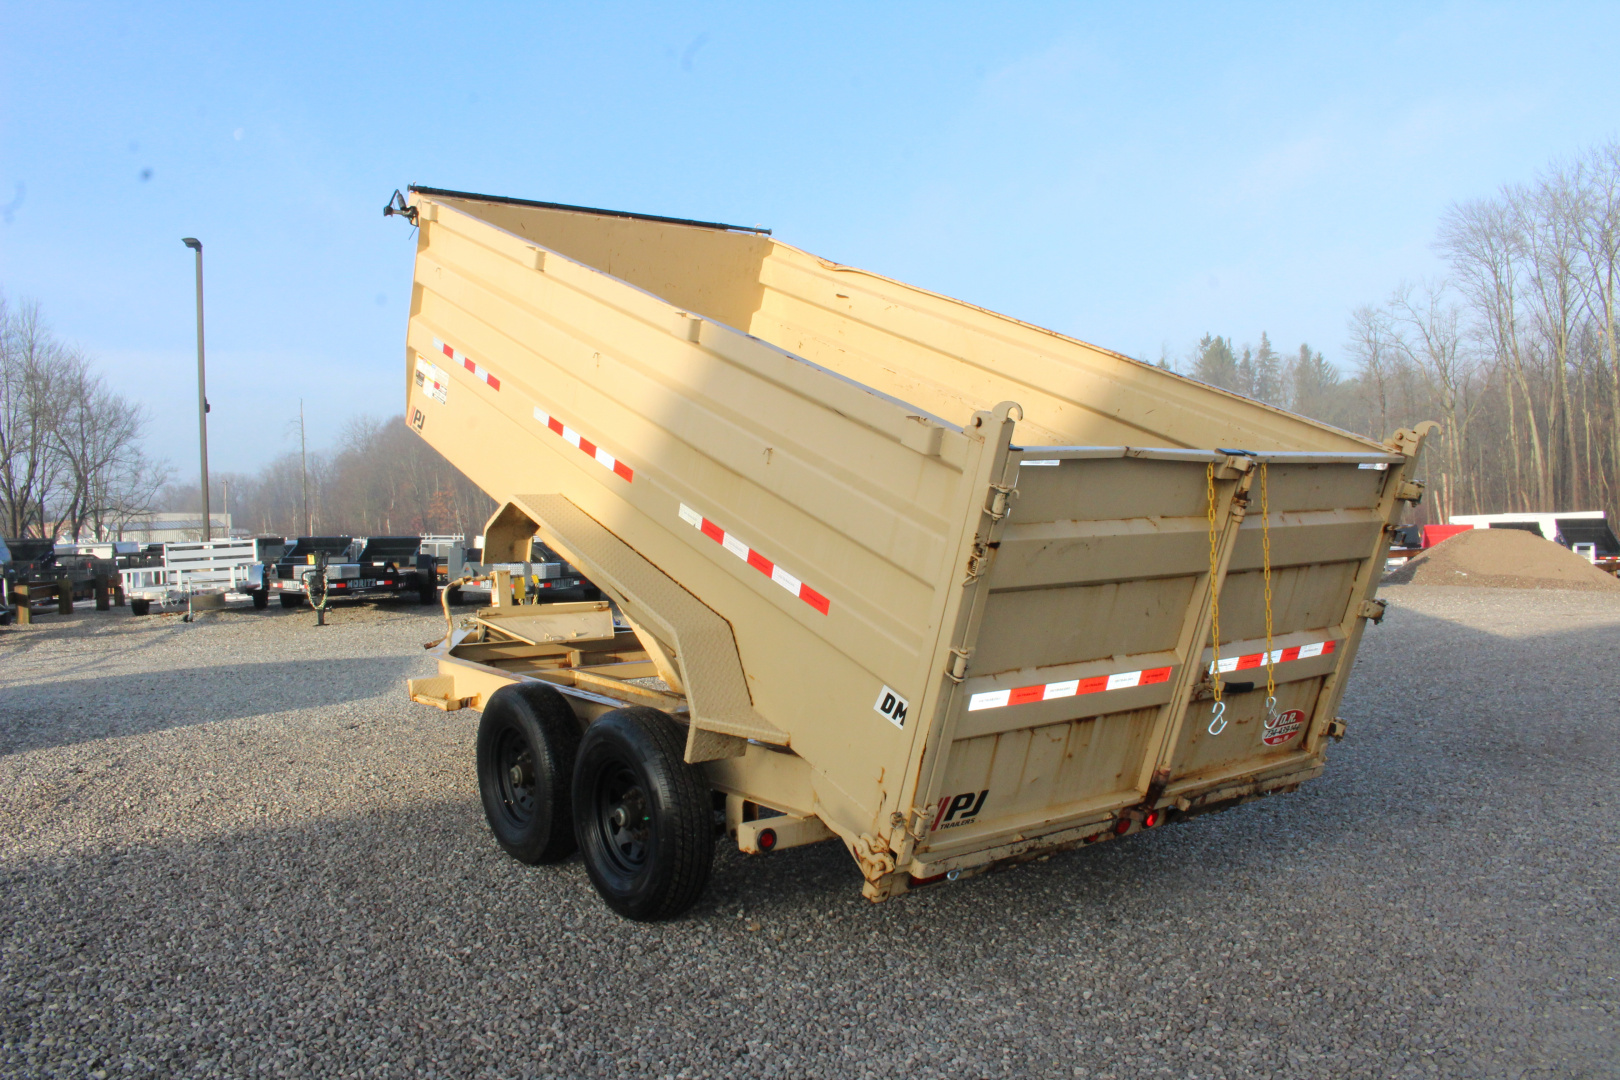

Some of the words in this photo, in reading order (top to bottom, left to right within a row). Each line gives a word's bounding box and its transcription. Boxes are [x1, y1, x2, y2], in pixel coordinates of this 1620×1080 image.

[413, 409, 425, 430] PJ
[346, 578, 376, 588] MORITZ
[880, 692, 908, 726] DM
[943, 789, 989, 822] PJ
[940, 818, 976, 830] TRAILERS
